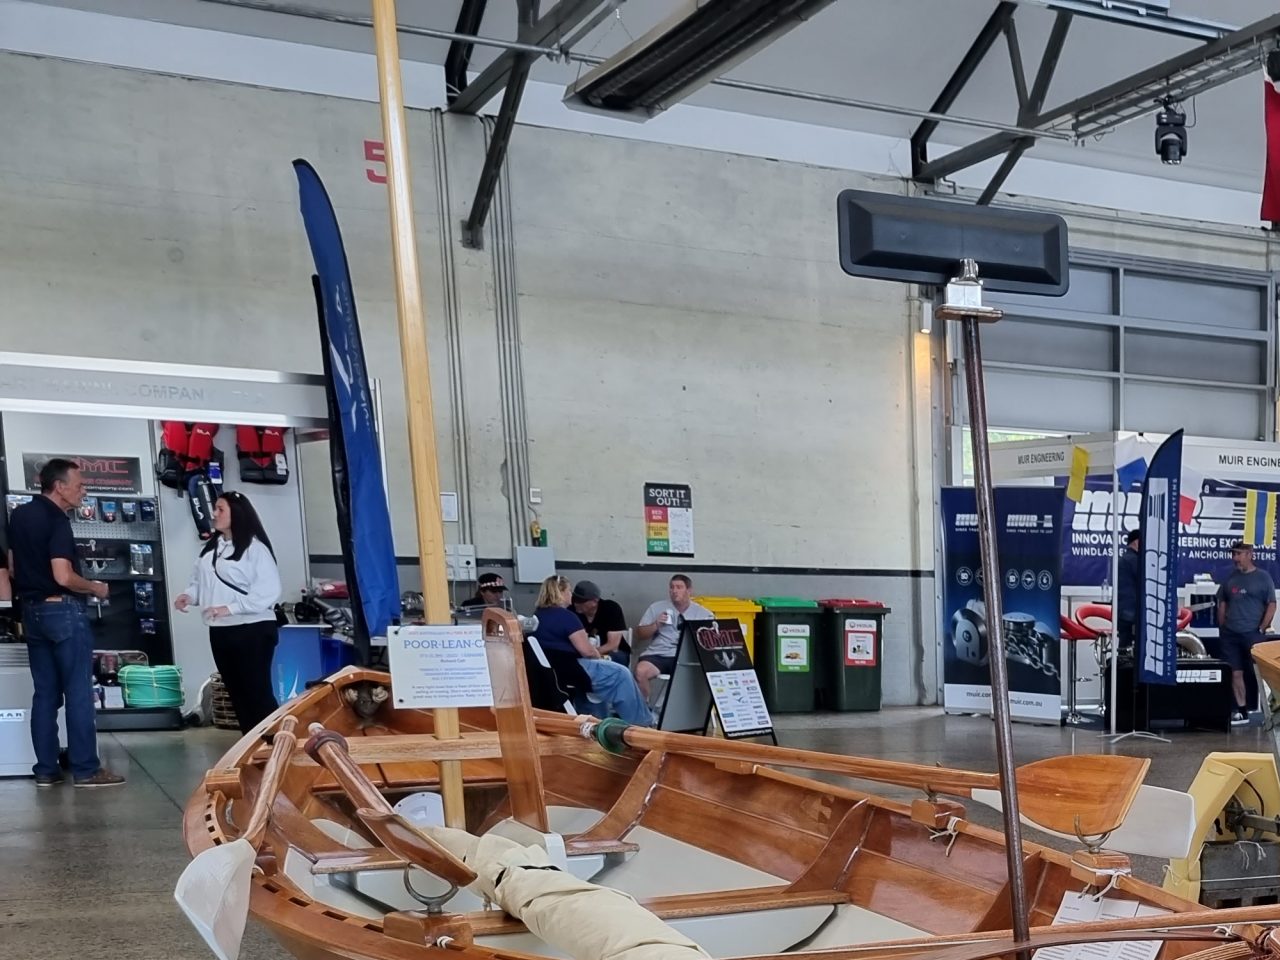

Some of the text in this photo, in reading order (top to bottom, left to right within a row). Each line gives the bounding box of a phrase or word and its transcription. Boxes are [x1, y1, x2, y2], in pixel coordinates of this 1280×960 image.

[364, 140, 388, 184] 5
[1017, 452, 1065, 465] MUIR ENGINEERING
[1218, 455, 1244, 466] MUIR
[649, 488, 686, 499] SORT IT
[656, 498, 680, 506] OUT!
[1189, 551, 1233, 560] ANCHORIN
[1252, 552, 1277, 561] STEMS
[1144, 549, 1168, 677] MUIR
